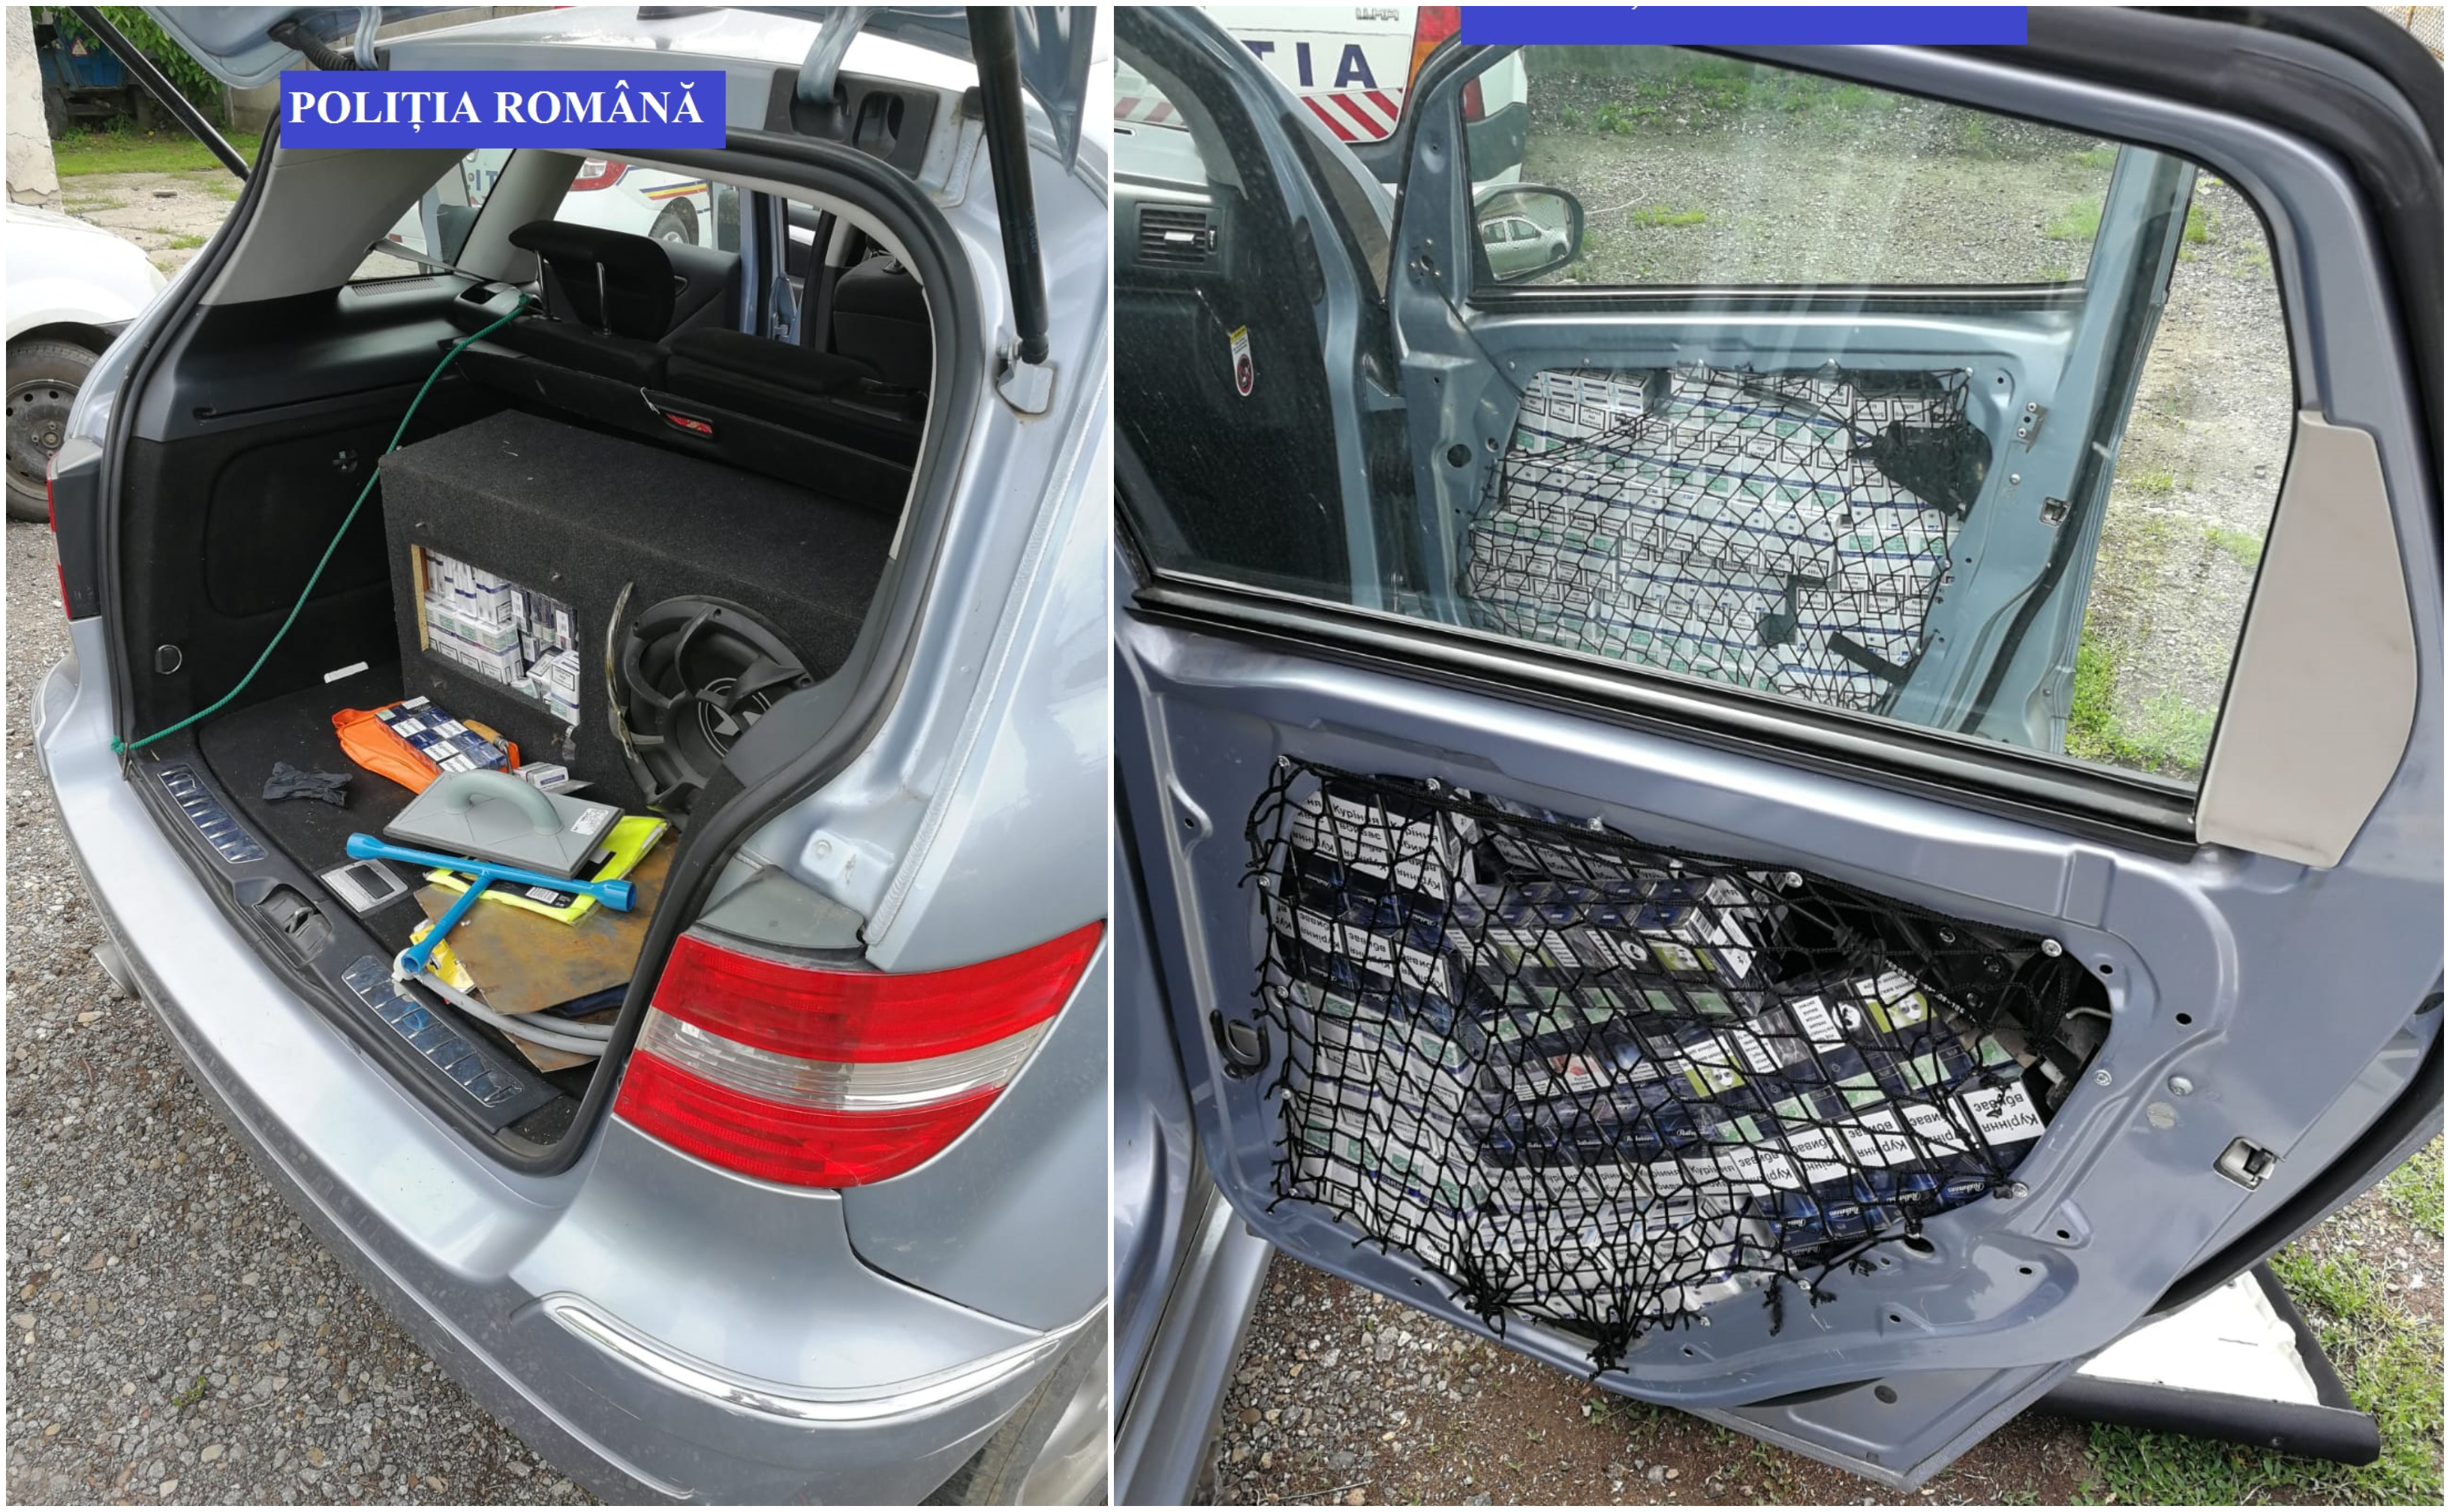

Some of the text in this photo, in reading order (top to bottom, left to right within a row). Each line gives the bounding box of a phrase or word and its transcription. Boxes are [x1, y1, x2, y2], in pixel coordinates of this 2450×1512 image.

[1849, 1120, 1894, 1139] вбиає
[1982, 1113, 2039, 1133] Куріння
[1857, 1138, 1908, 1159] Курння
